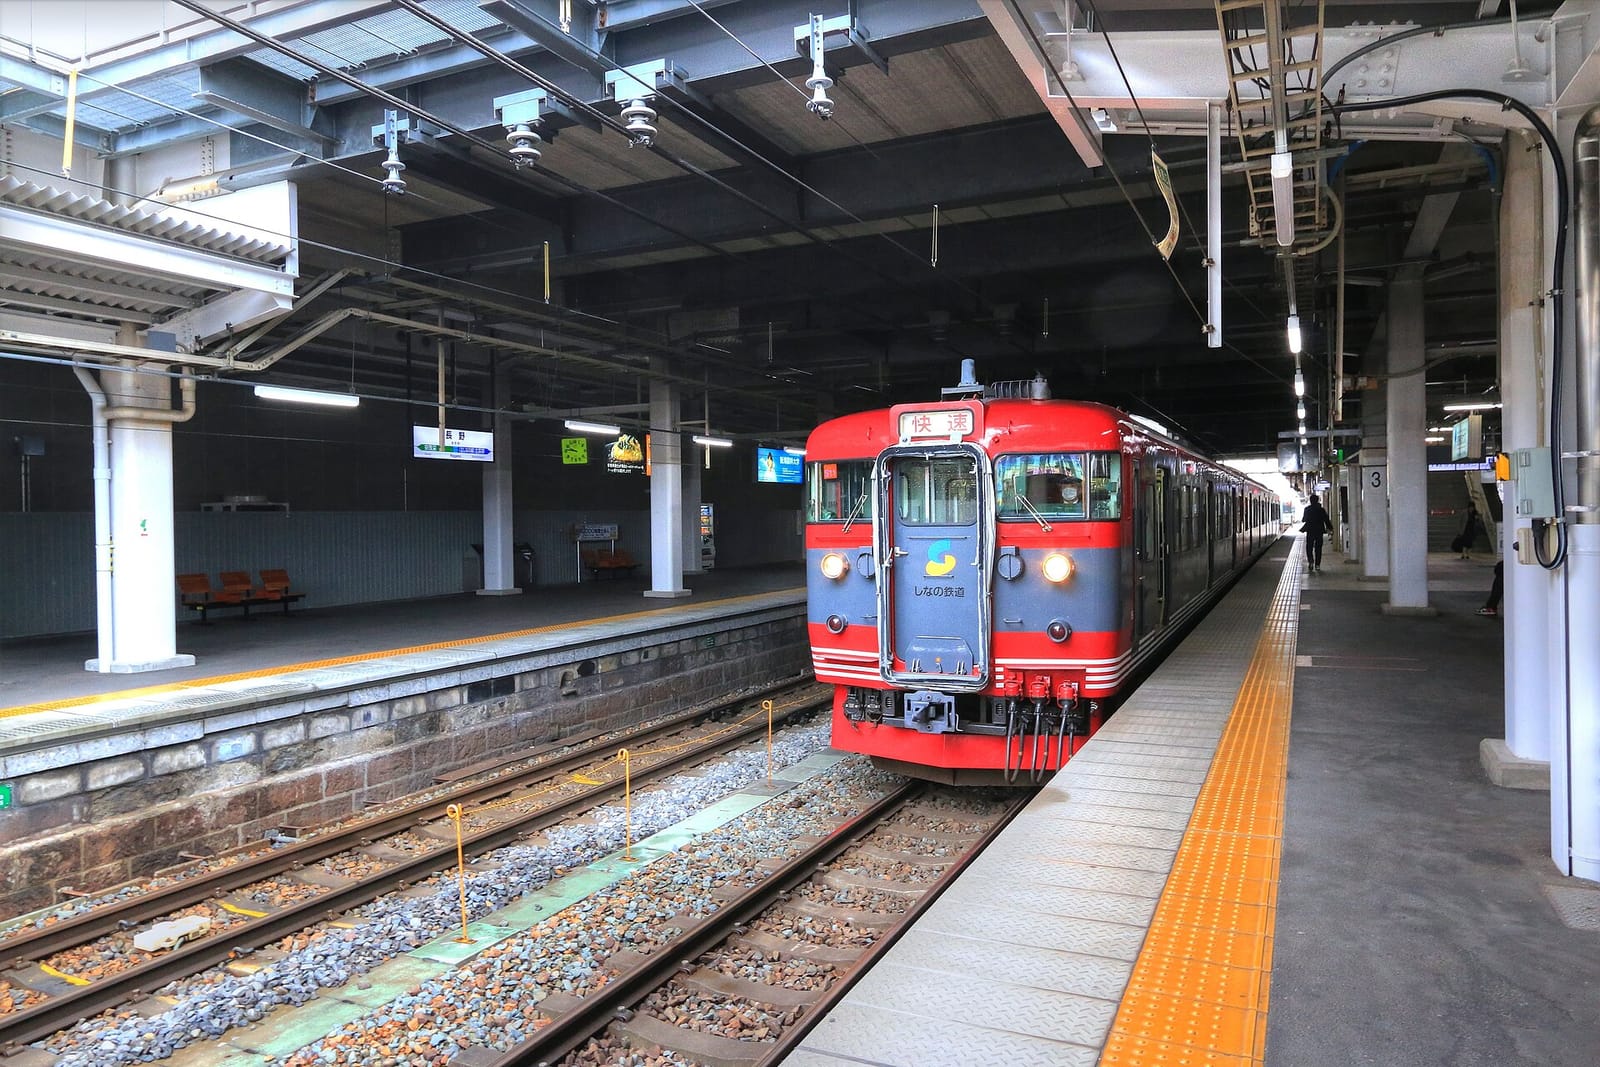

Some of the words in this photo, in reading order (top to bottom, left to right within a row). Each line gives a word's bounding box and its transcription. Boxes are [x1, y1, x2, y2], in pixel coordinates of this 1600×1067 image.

[912, 413, 968, 433] 快速
[445, 430, 465, 441] 長野
[1371, 471, 1381, 488] 3
[914, 586, 965, 598] しなの鉄道
